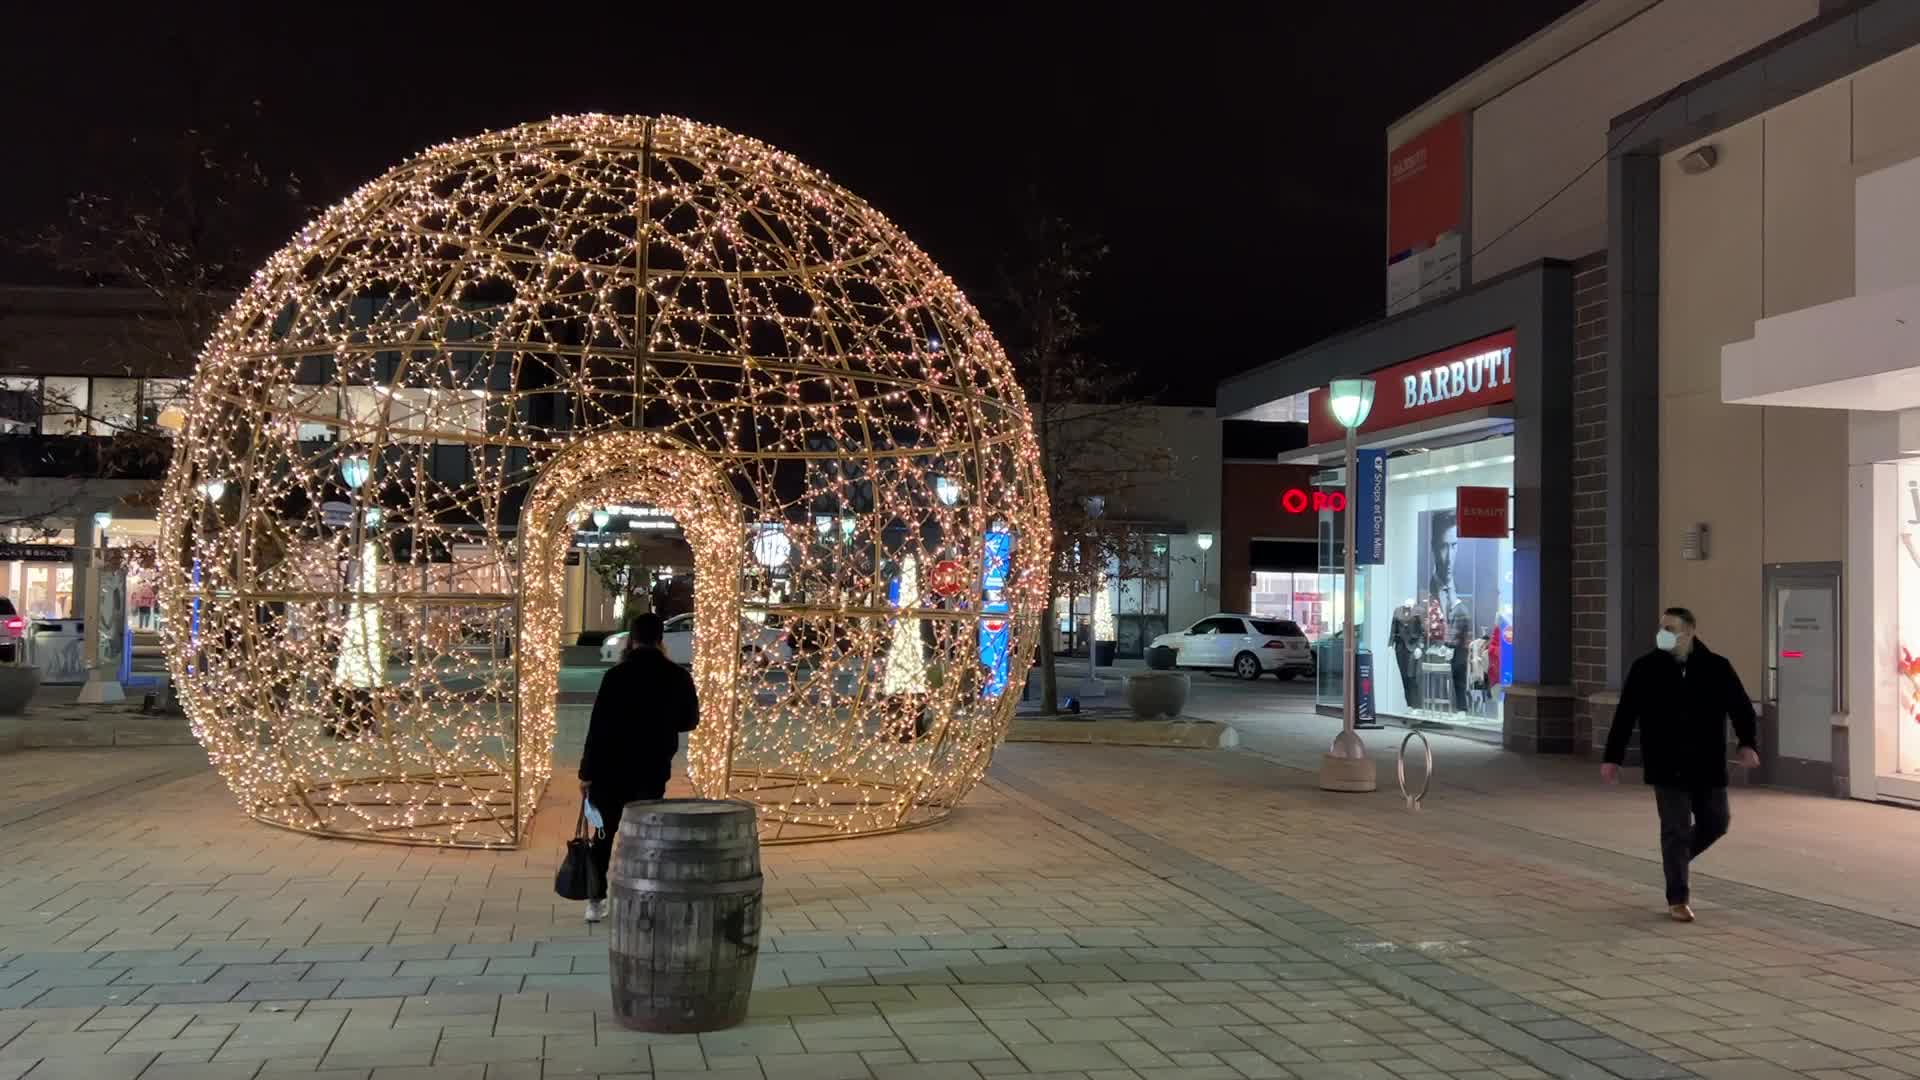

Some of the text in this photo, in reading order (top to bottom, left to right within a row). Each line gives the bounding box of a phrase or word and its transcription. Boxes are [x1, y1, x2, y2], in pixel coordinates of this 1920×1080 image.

[1403, 348, 1512, 408] BARBUTI
[1374, 456, 1383, 473] CF
[1372, 473, 1383, 502] Shops
[1374, 504, 1382, 515] at
[1374, 515, 1383, 535] Don
